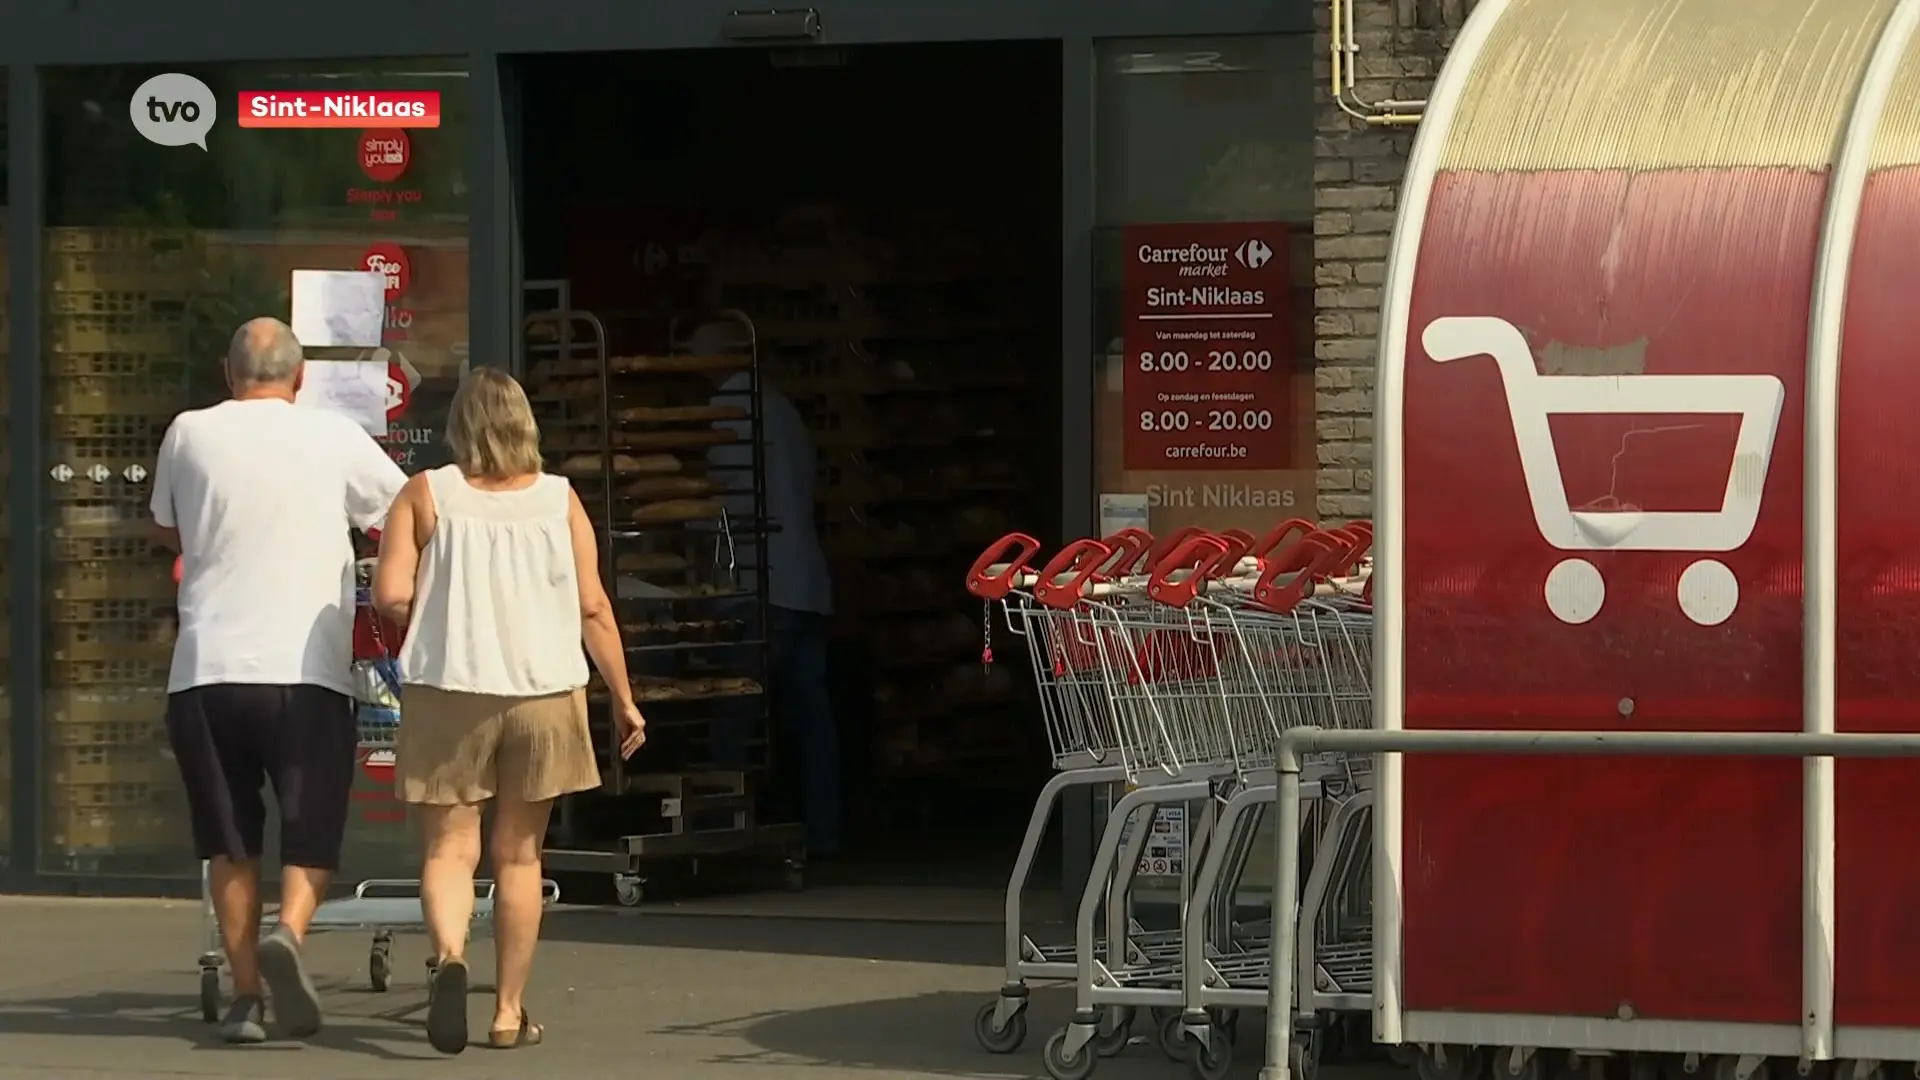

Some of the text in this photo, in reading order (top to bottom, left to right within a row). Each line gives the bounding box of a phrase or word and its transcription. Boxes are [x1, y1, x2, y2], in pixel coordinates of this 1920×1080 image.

[364, 138, 404, 154] simply
[364, 153, 386, 168] you
[346, 188, 422, 204] Simply you
[1138, 243, 1229, 263] Carrefour
[1178, 262, 1229, 279] market
[1147, 286, 1265, 307] Sint-Niklaas
[1156, 330, 1256, 341] Van maandag tot zaterdag
[1139, 351, 1189, 372] 8.00
[1208, 350, 1272, 371] 20.00
[1157, 392, 1170, 403] Op
[1171, 392, 1199, 403] zondag
[1211, 392, 1255, 403] feestdagen
[1140, 411, 1190, 431] 8.00
[1208, 410, 1272, 431] 20.00
[1165, 443, 1248, 458] carrefour.be
[1146, 484, 1296, 507] Sint Niklaas
